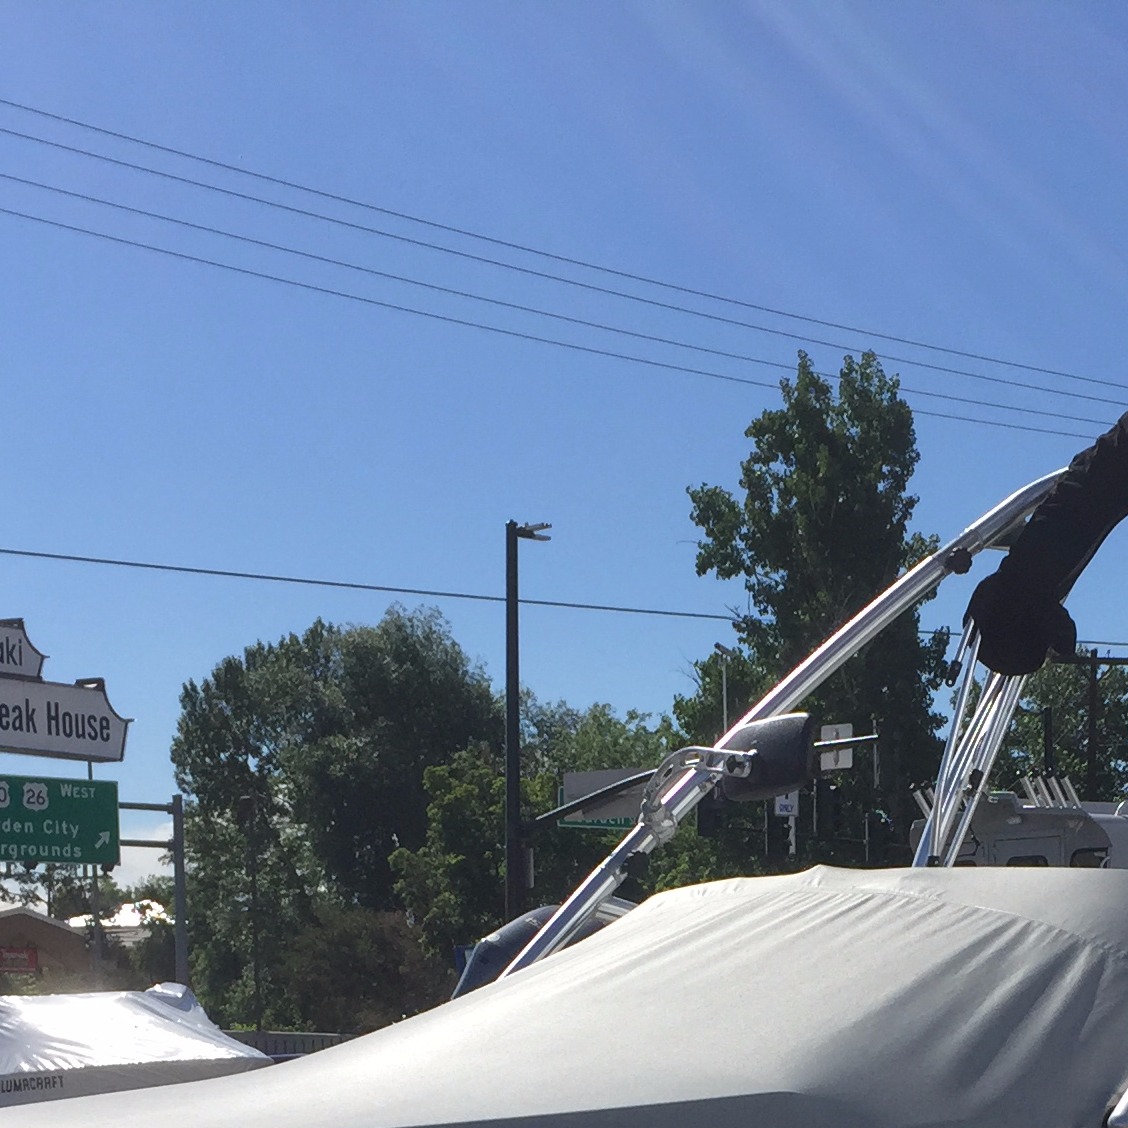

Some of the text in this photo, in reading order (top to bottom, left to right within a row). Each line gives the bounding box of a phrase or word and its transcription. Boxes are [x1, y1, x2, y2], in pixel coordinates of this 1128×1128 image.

[0, 698, 111, 742] eak House
[26, 788, 46, 805] 26
[60, 783, 96, 798] WEST
[1, 818, 79, 839] den City
